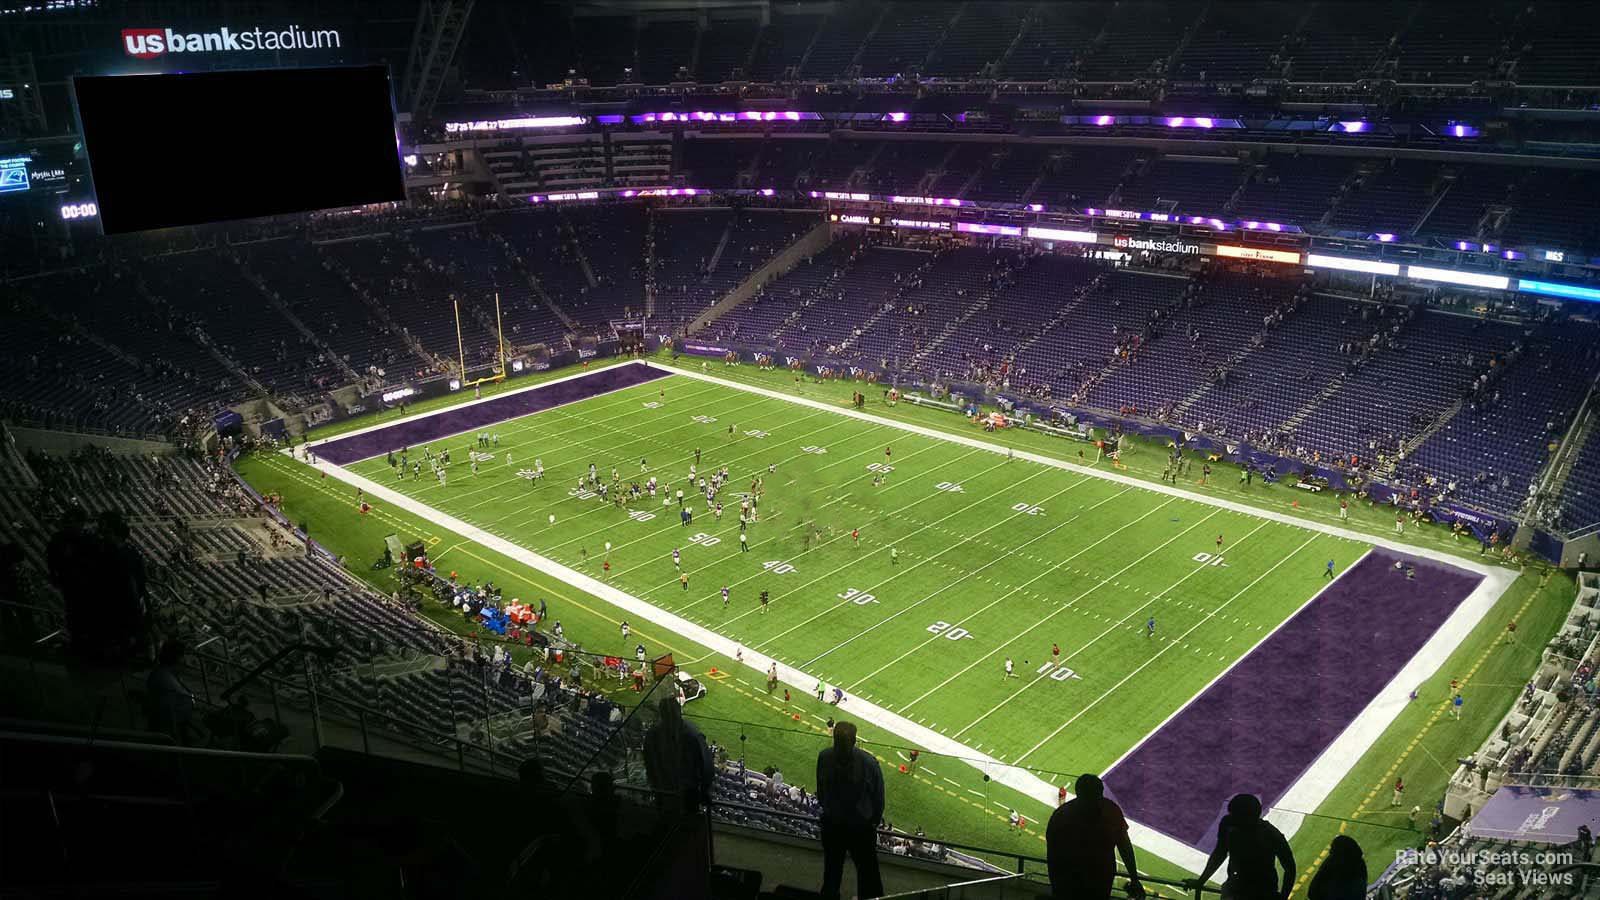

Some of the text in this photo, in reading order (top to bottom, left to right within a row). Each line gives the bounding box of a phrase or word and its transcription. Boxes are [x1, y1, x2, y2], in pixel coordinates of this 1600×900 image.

[688, 532, 721, 546] 50
[763, 560, 796, 574] 40
[837, 588, 875, 605] 30
[926, 621, 969, 641] 20
[1036, 662, 1075, 681] 10
